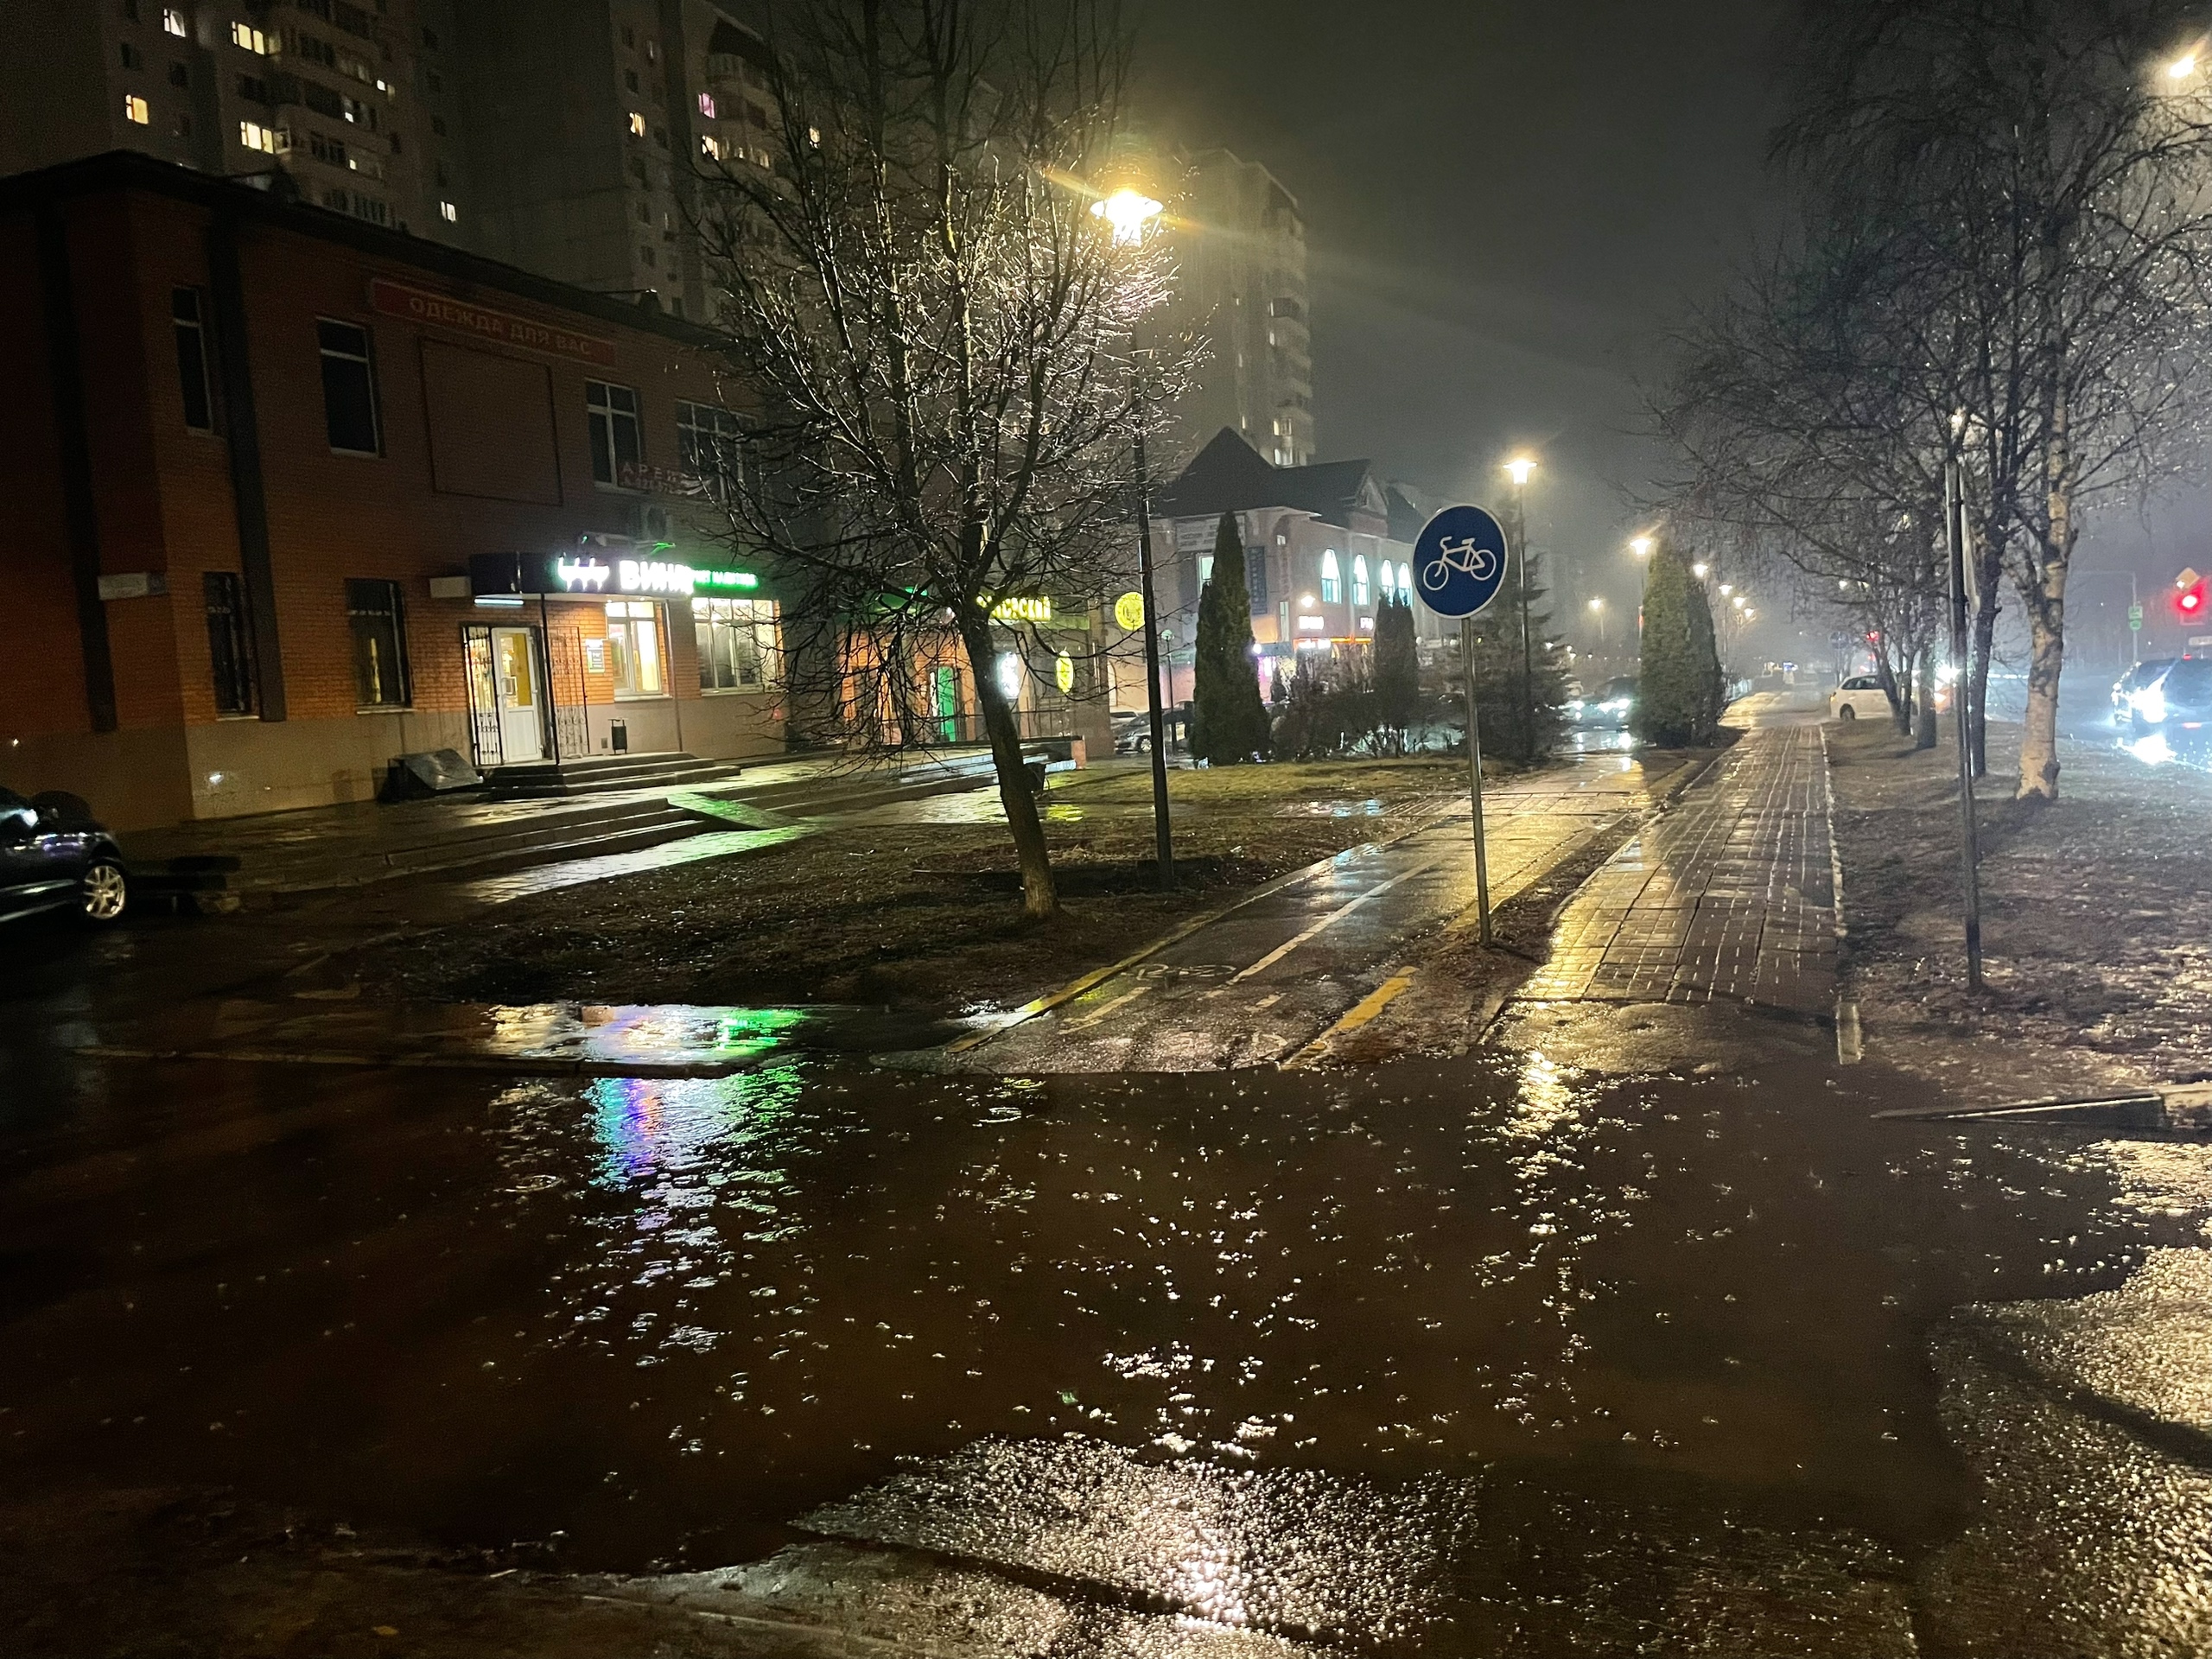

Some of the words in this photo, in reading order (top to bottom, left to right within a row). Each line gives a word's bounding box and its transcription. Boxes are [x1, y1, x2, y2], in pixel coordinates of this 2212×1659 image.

[410, 297, 504, 335] ОДЕЖДА
[510, 324, 550, 346] ДЛЯ
[556, 334, 591, 355] ВАС
